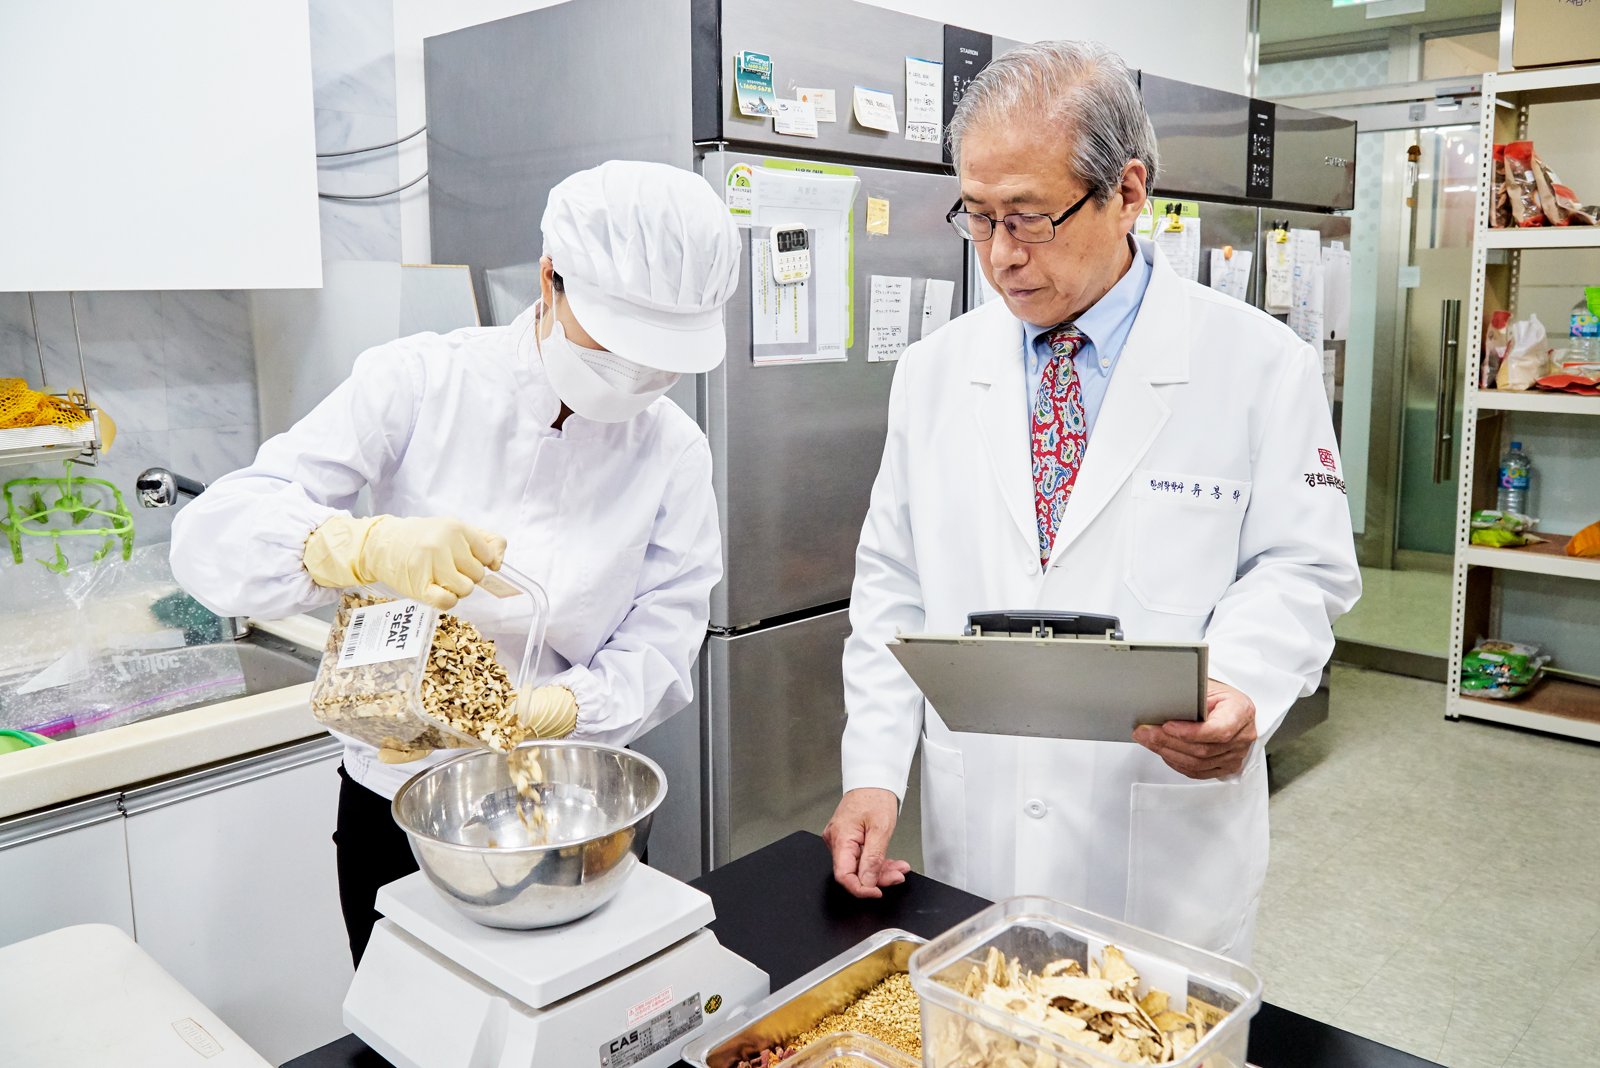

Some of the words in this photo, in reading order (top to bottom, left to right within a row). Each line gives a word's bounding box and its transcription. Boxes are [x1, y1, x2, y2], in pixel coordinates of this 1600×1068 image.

[385, 613, 403, 648] SEAL
[395, 605, 415, 650] SMART
[609, 1030, 639, 1055] CAS
